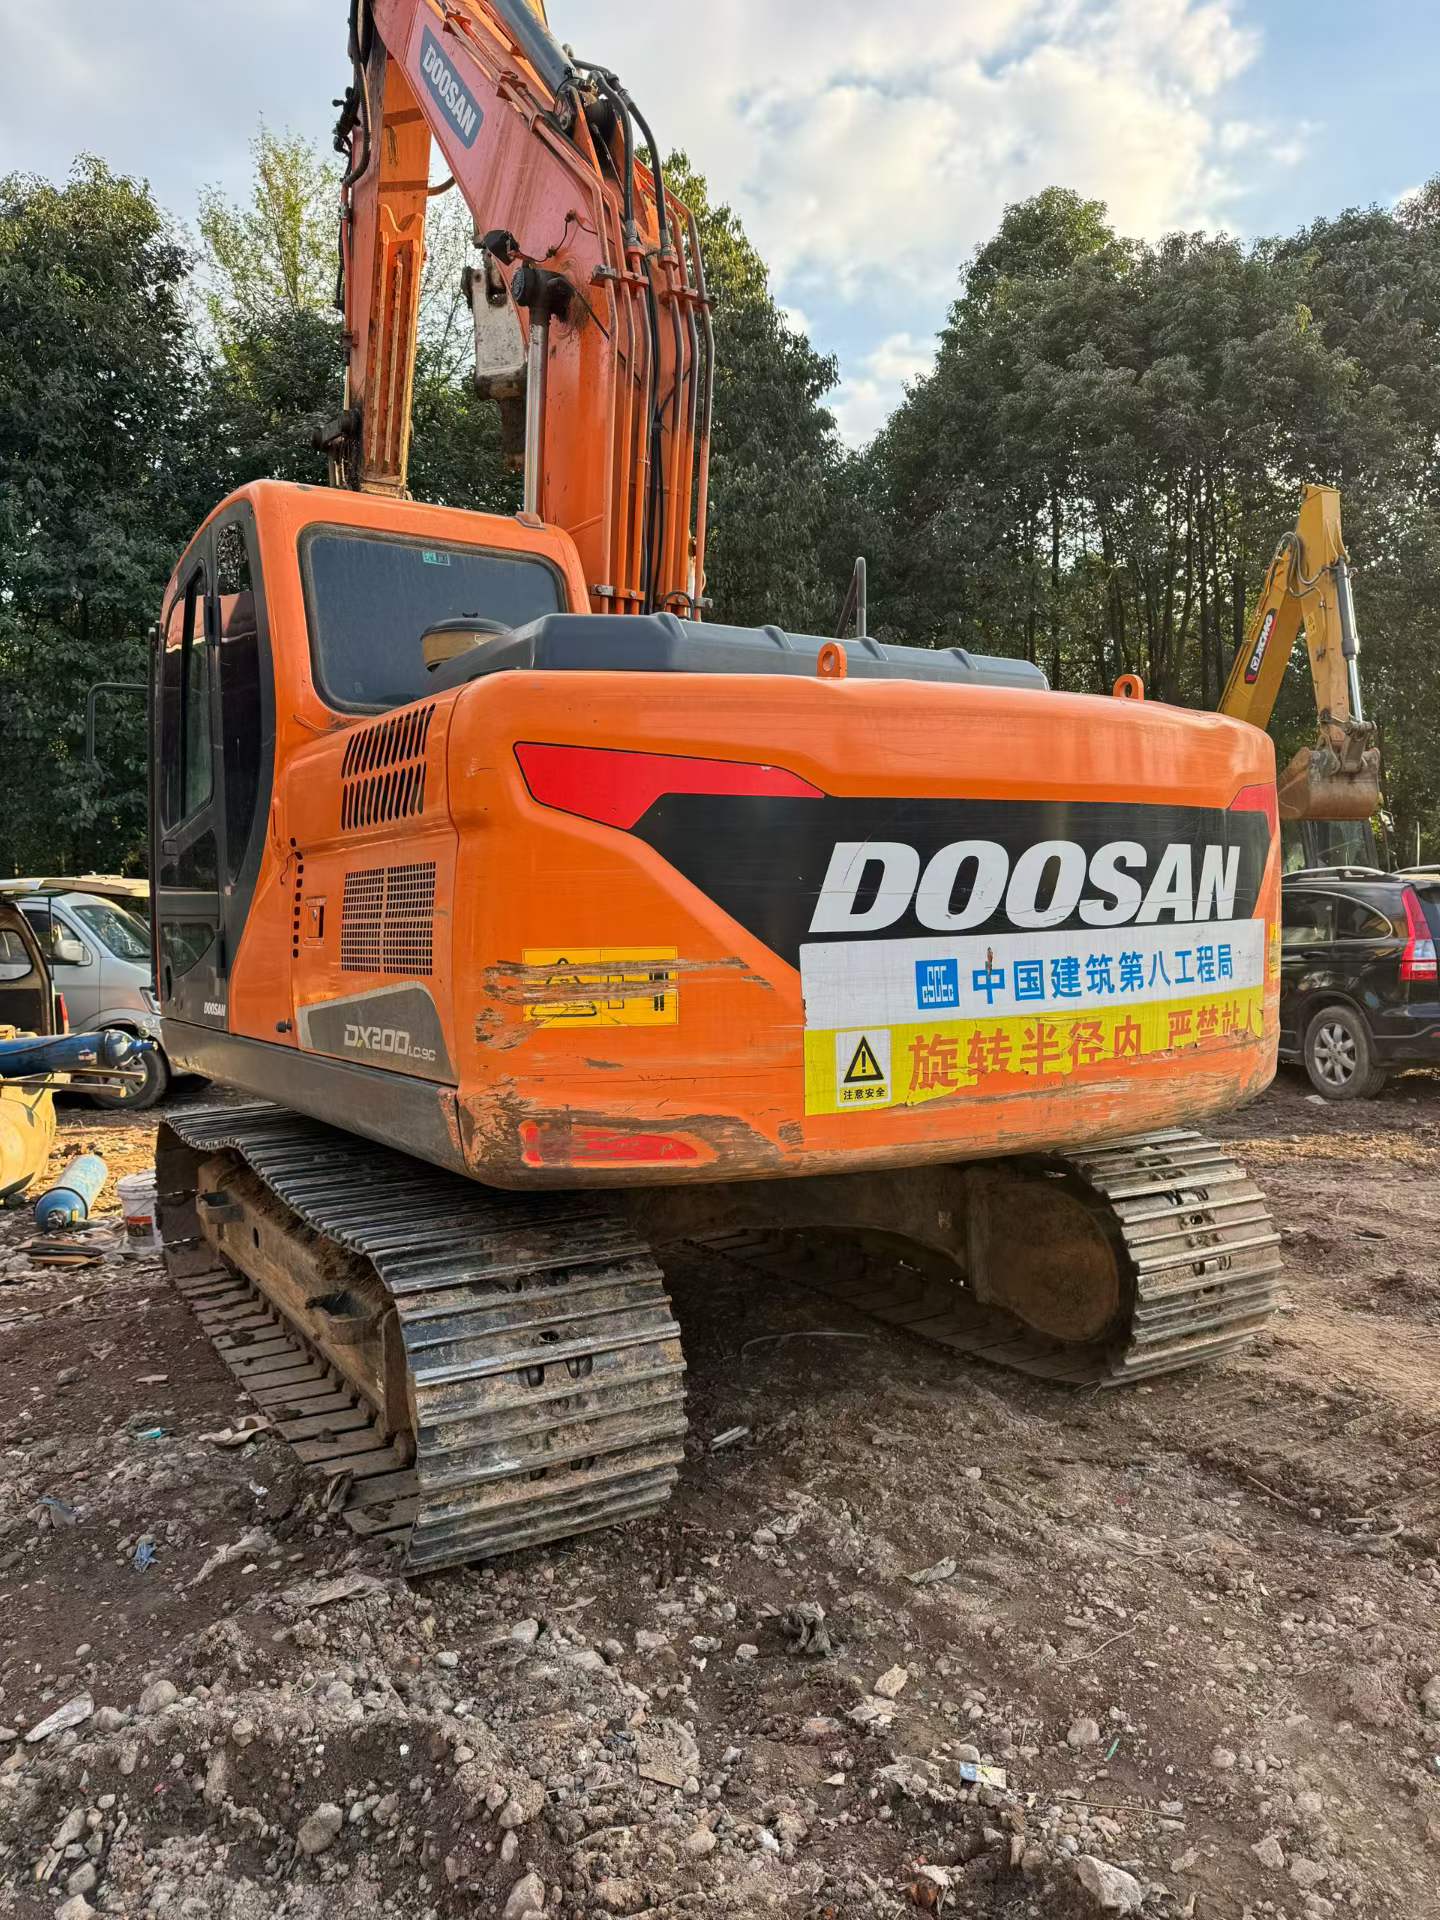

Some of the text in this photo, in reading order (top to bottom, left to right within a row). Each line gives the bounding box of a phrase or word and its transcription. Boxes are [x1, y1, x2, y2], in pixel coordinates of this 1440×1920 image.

[422, 43, 477, 137] DOOSAN
[808, 840, 1240, 933] DOOSAN
[972, 943, 1233, 1005] 中国建筑第八工程局
[203, 1001, 226, 1017] DOOSAN
[908, 1015, 1142, 1091] 旋转半径内
[843, 1087, 886, 1100] 注意安全
